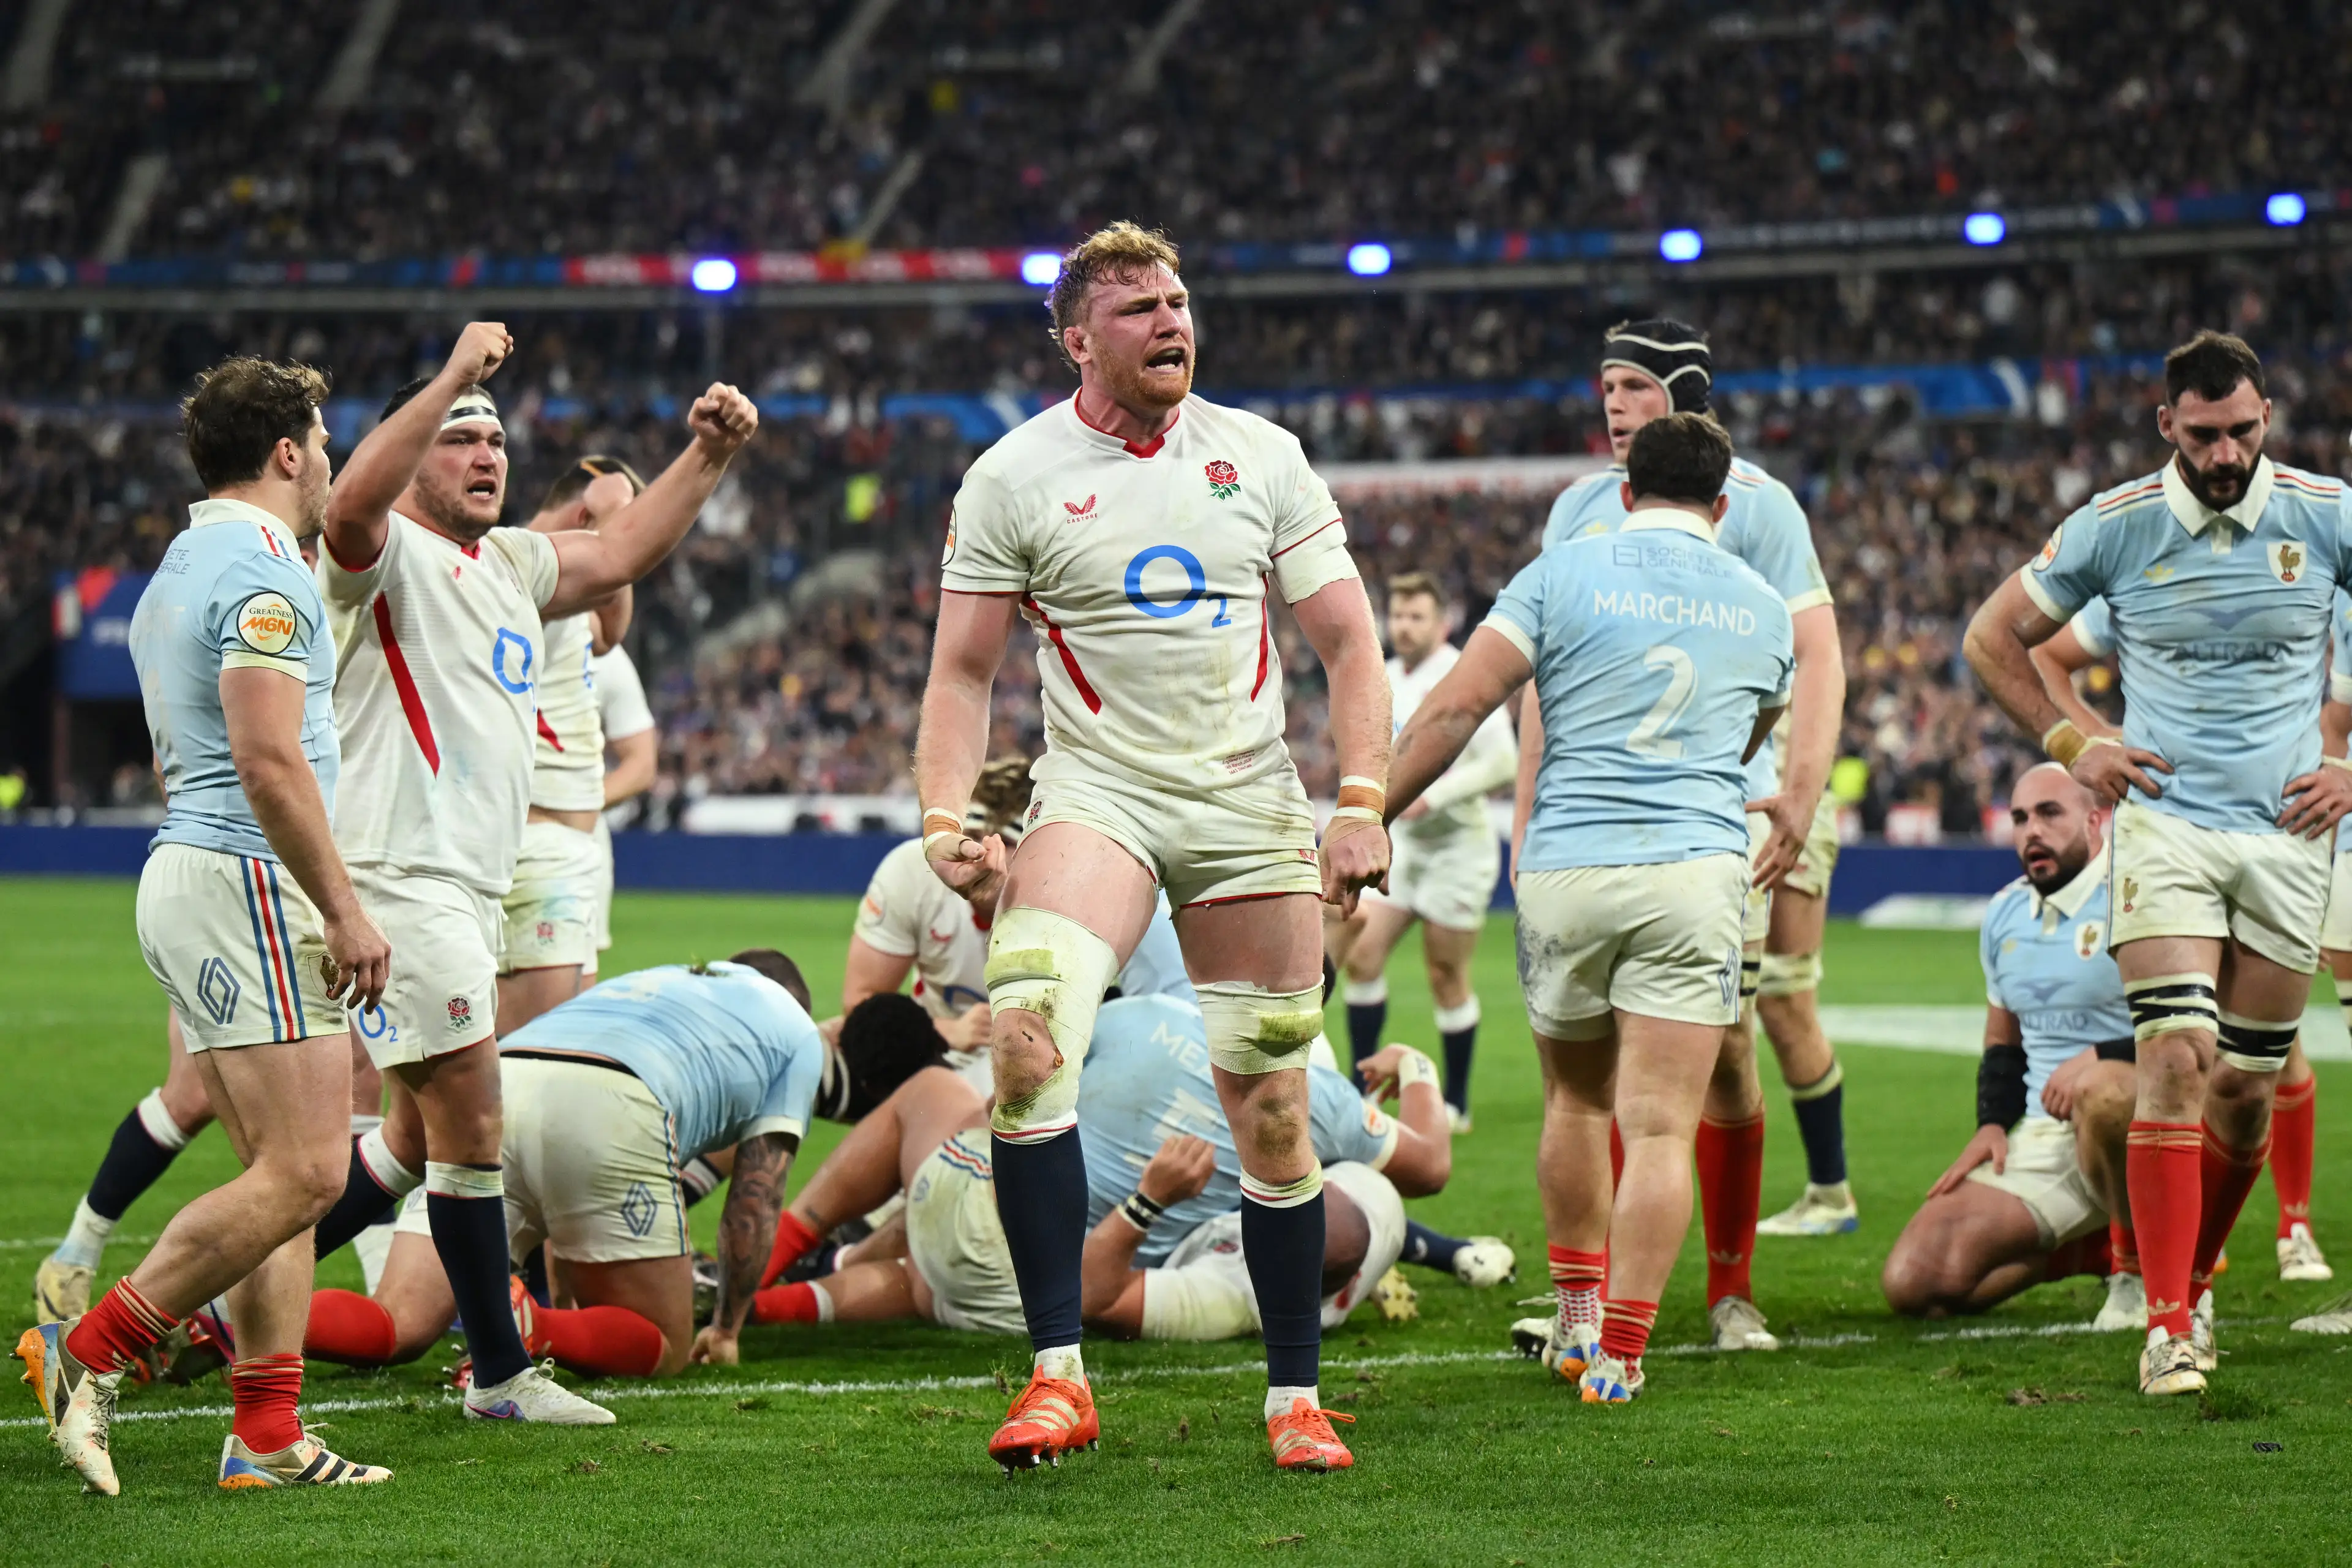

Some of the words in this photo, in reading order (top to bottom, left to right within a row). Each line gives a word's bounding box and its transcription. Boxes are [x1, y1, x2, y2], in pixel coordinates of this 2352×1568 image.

[1066, 513, 1098, 524] CASTORE
[1124, 545, 1232, 628] O2
[249, 607, 293, 619] GREATNESS
[1593, 589, 1756, 636] MARCHAND
[1625, 644, 1698, 760] 2
